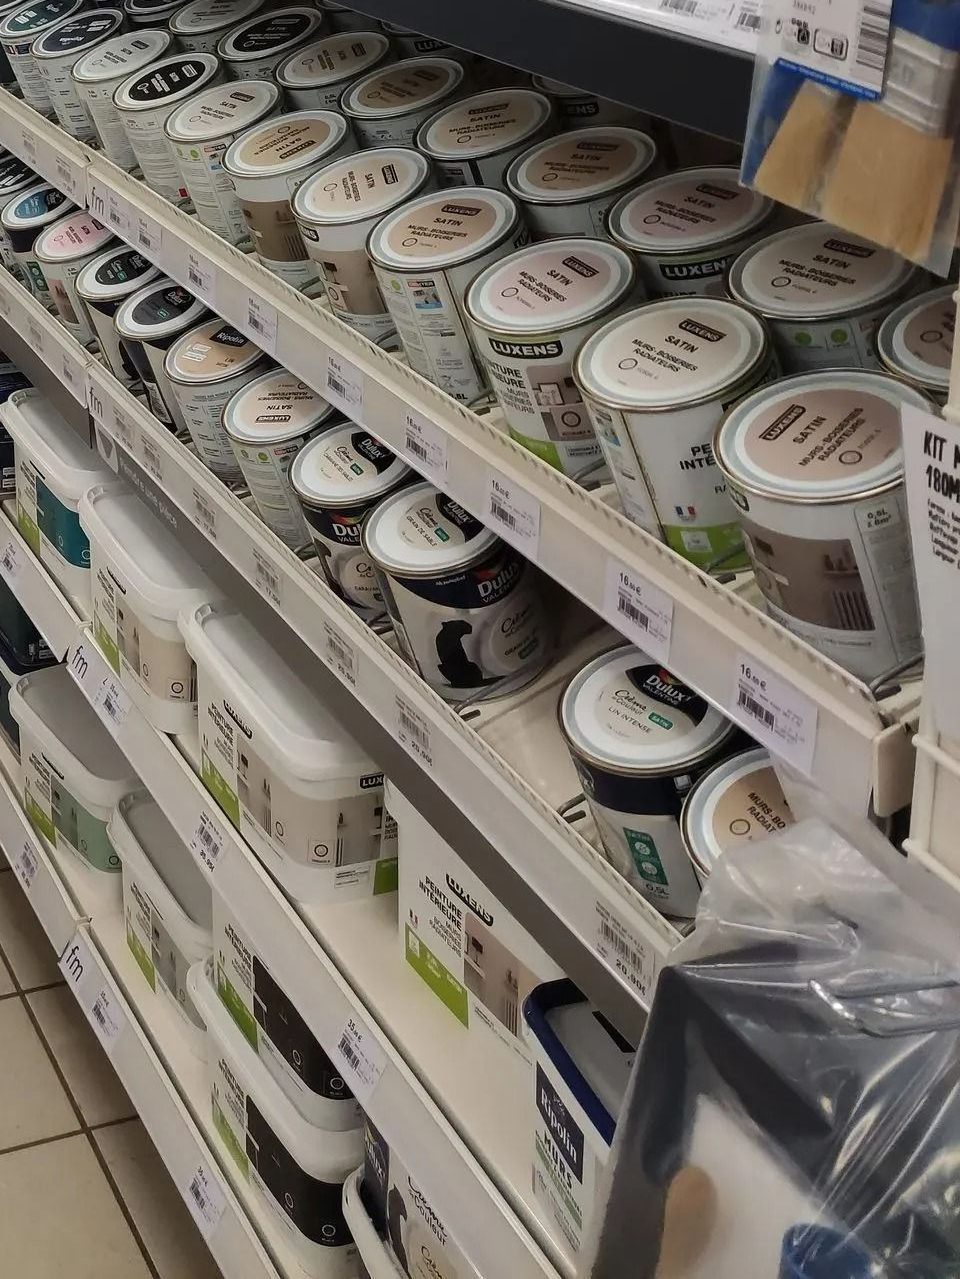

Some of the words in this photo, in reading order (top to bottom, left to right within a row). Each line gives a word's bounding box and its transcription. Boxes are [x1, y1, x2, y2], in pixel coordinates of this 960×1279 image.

[91, 186, 105, 218] fm
[433, 217, 464, 226] SATIN
[546, 269, 574, 286] SATIN
[665, 260, 727, 278] LUXEN
[682, 321, 721, 342] LUXENS
[491, 341, 559, 357] LUXENS
[665, 335, 699, 354] SATIN
[633, 347, 681, 373] RADIATEURS
[793, 415, 828, 444] SATIN
[361, 438, 385, 458] Dulux
[691, 442, 712, 456] PE
[923, 430, 947, 462] KIT
[679, 456, 716, 471] INTÉ
[926, 464, 960, 504] 180M
[446, 500, 472, 524] Dulux
[332, 524, 361, 537] Dul
[71, 645, 89, 679] fm
[614, 688, 648, 712] Crème
[646, 674, 685, 702] Dulux
[608, 706, 623, 718] LIN
[621, 710, 651, 734] INTENSE
[361, 775, 384, 787] LUX
[746, 805, 777, 834] RADIAT
[747, 791, 787, 830] MURS-BO
[425, 875, 462, 920] PEINTURE
[65, 945, 84, 982] fm
[541, 1087, 577, 1165] Ripolin
